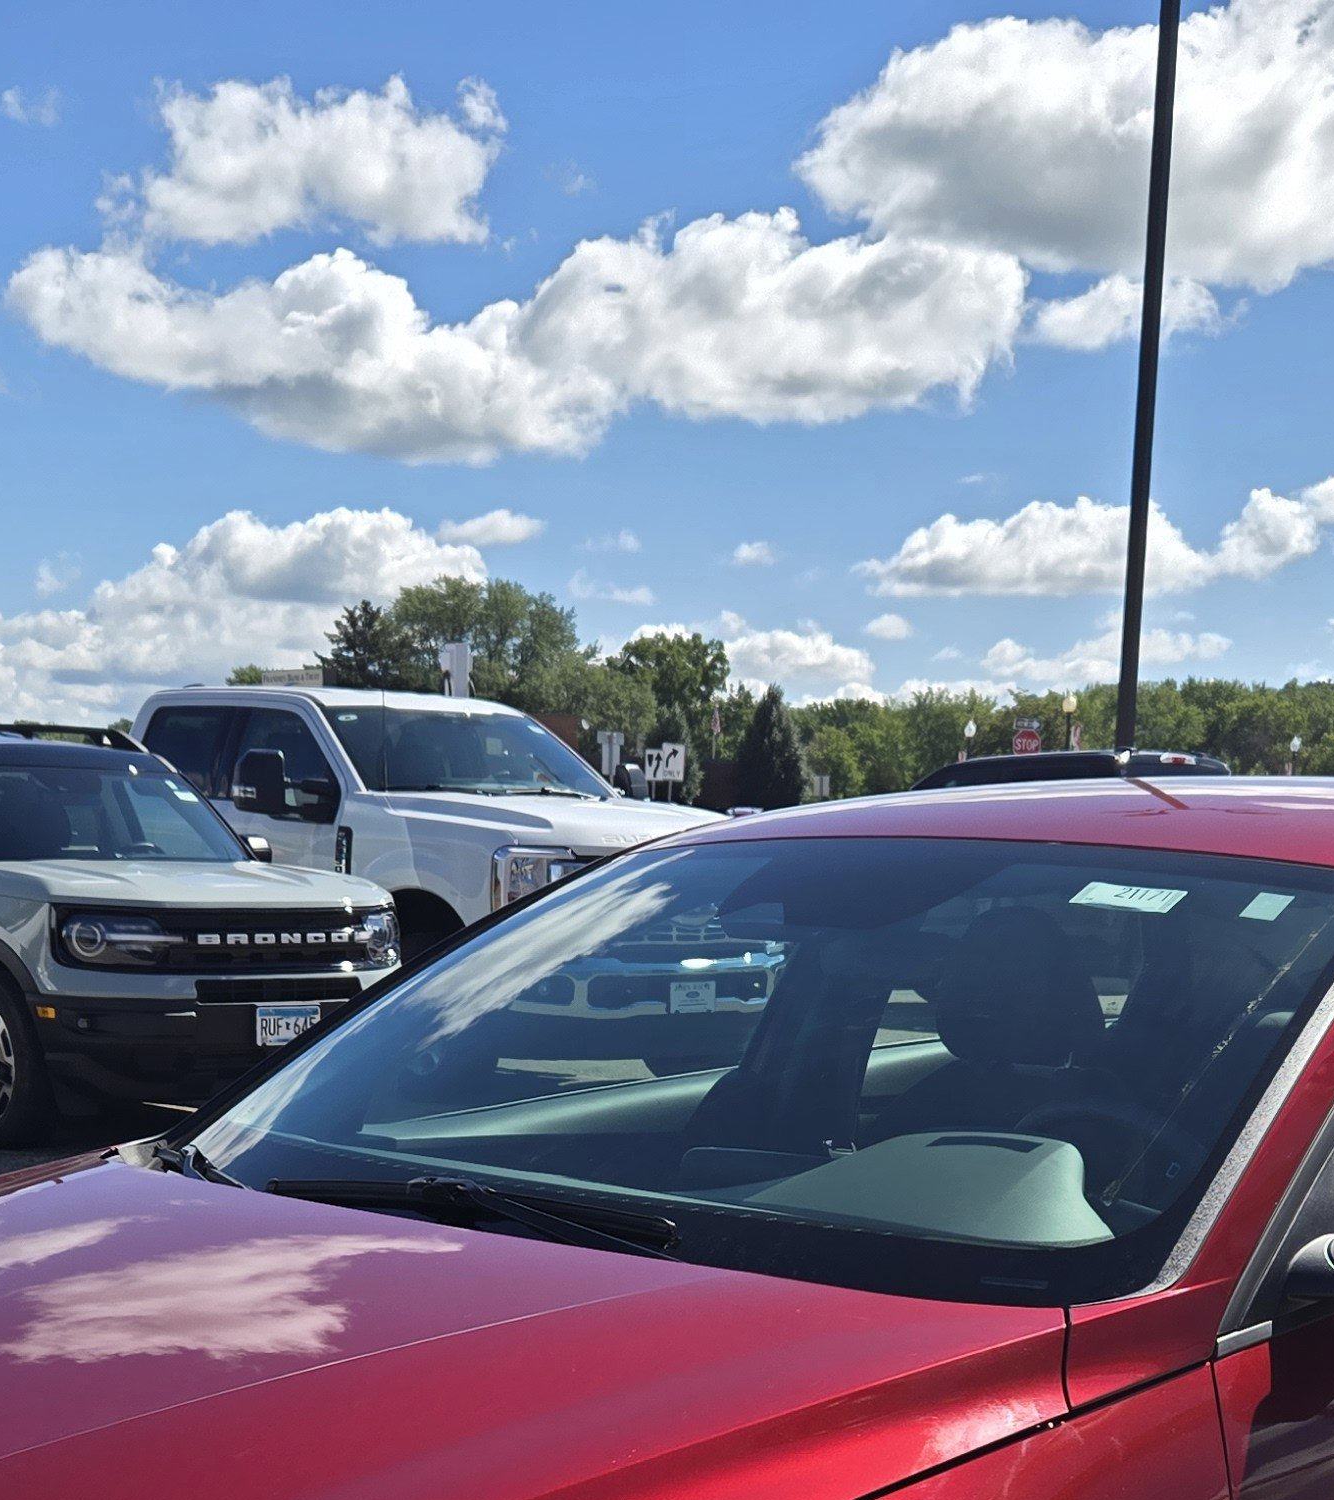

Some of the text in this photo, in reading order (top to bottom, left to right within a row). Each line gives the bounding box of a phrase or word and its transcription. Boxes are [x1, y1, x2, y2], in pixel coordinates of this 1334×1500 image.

[1014, 738, 1039, 751] STOP
[197, 932, 349, 945] BRONCO
[260, 1018, 283, 1036] RUF
